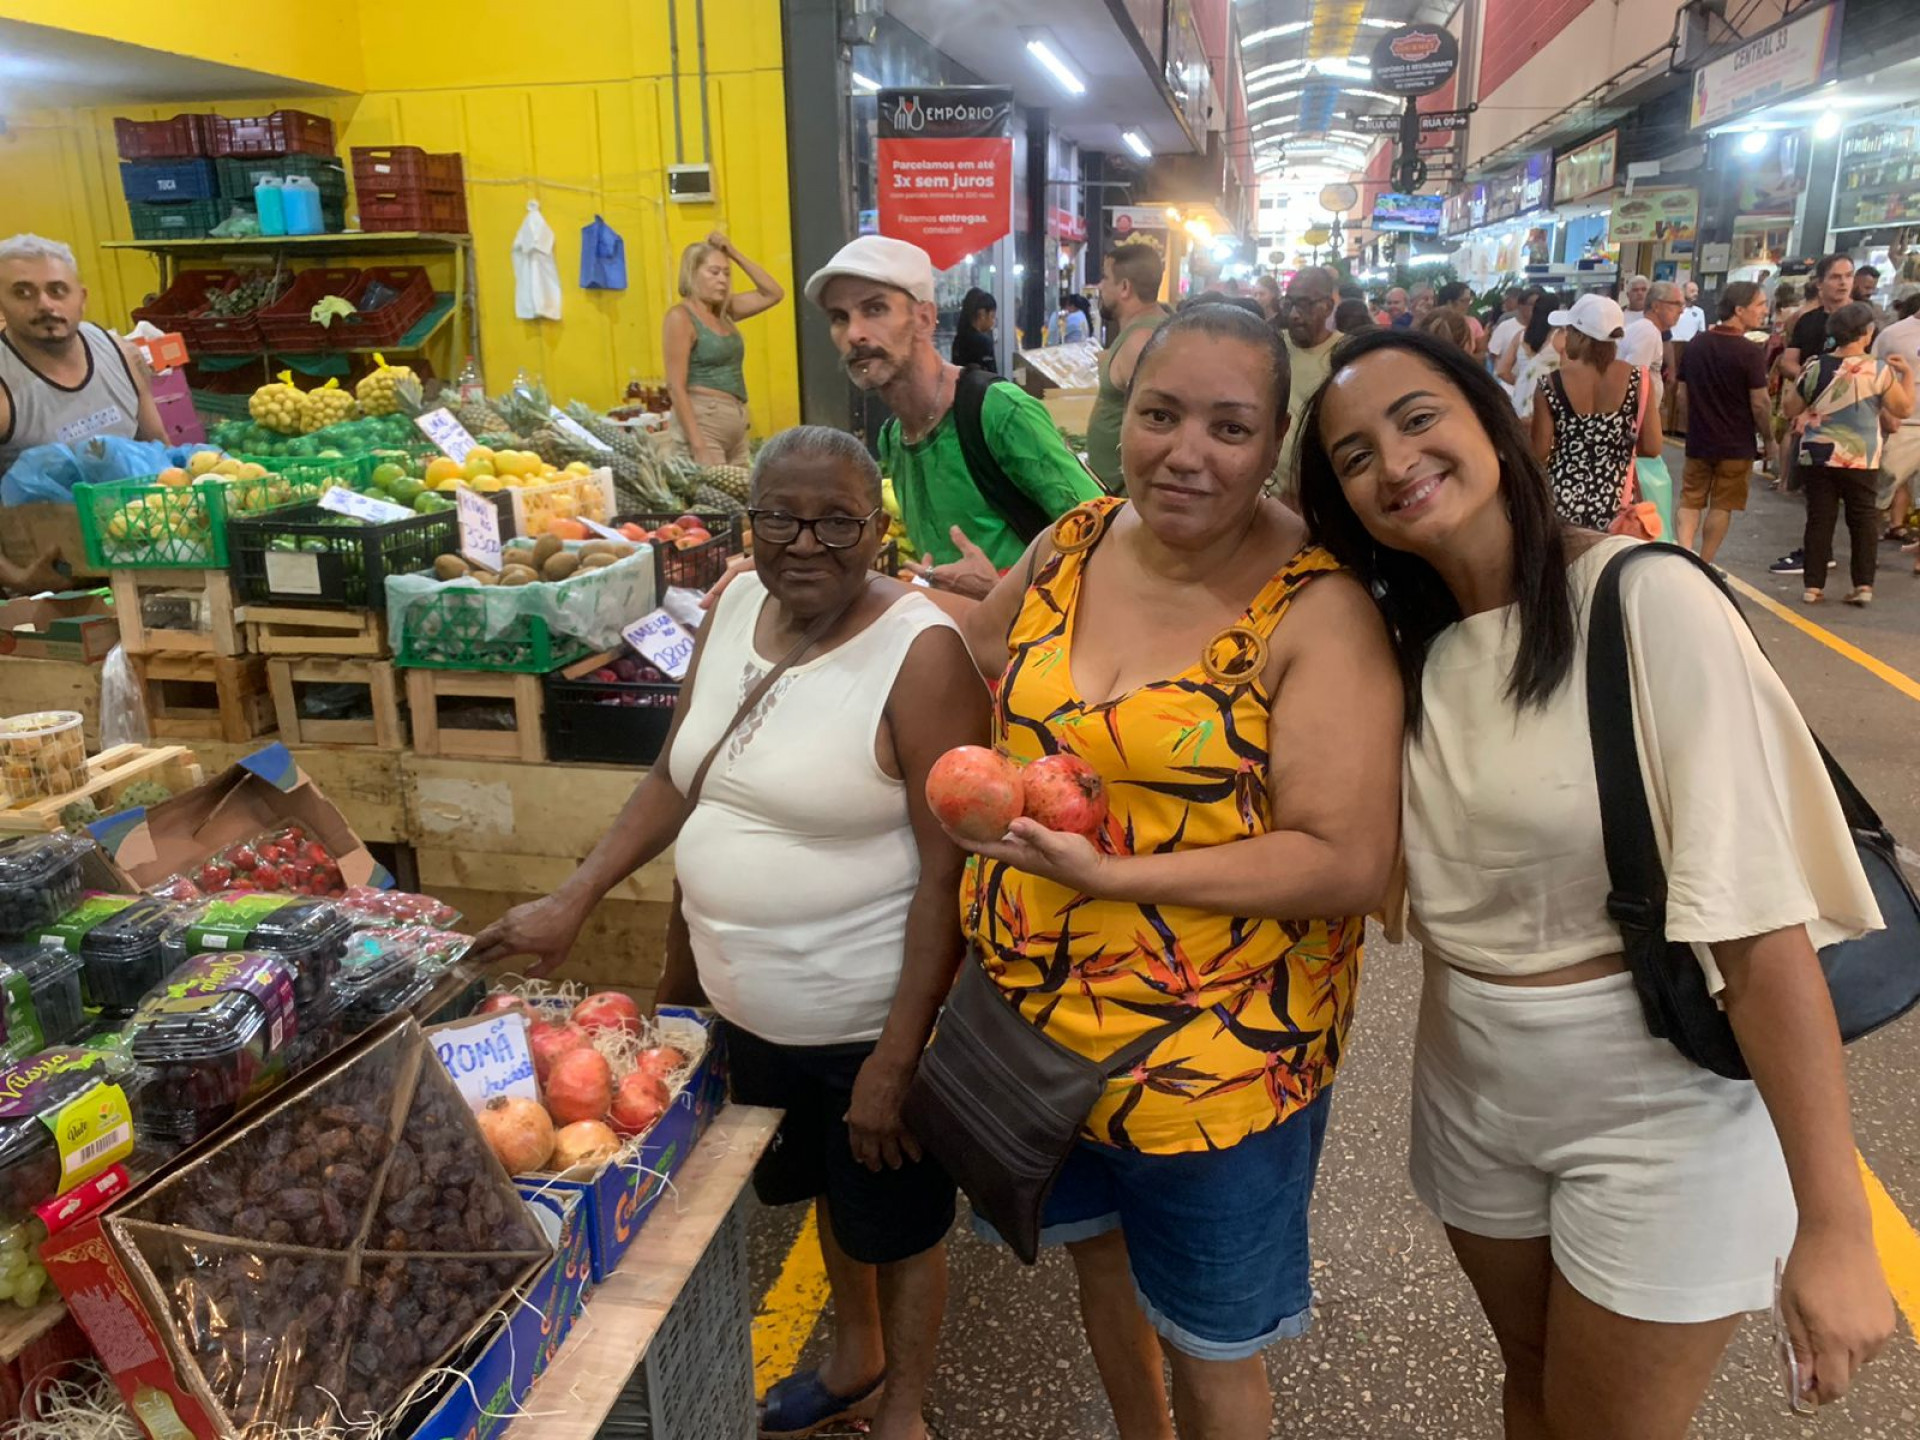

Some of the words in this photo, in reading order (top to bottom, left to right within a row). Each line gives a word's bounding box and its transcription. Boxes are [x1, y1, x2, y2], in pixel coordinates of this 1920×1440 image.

[1733, 36, 1773, 71] CENTRAL
[1775, 28, 1789, 52] 33
[926, 104, 994, 121] EMPÓRIO
[1366, 120, 1385, 129] RUA
[1386, 120, 1398, 129] 08
[1422, 119, 1442, 128] RUA
[1443, 118, 1455, 126] 09
[892, 160, 955, 170] Parcelamos
[957, 162, 975, 170] em
[977, 160, 995, 170] até
[157, 179, 176, 191] TUCA
[893, 174, 911, 188] 3x
[915, 175, 949, 188] sem
[952, 173, 995, 191] juros
[898, 214, 937, 223] Fazemos
[437, 1018, 515, 1079] ROMÃ
